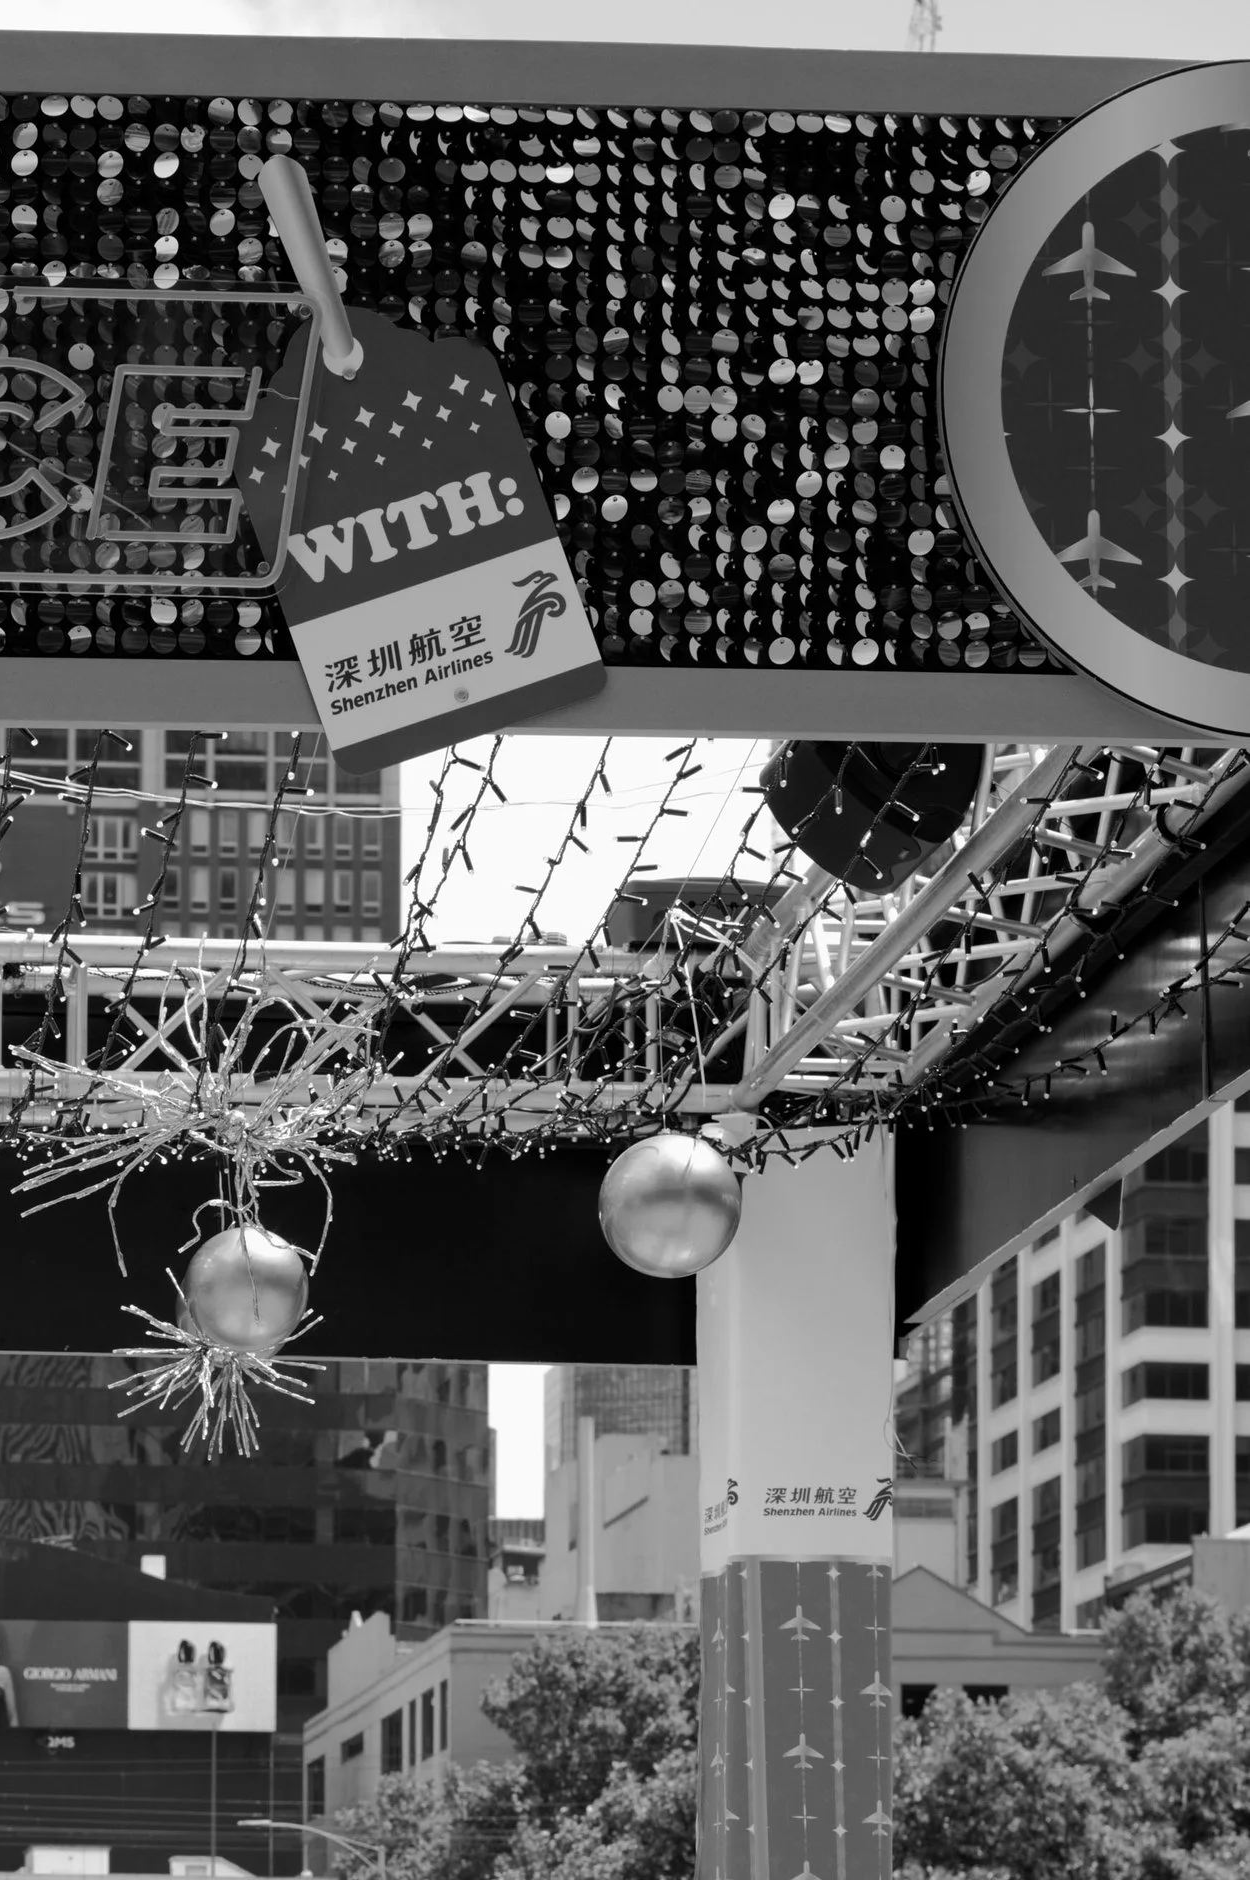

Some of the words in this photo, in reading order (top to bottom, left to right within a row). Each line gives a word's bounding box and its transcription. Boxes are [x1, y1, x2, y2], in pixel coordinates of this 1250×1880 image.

[287, 471, 524, 583] WITH:
[324, 614, 486, 693] 深圳航空
[330, 675, 418, 716] Shenzhen
[424, 650, 494, 684] Airlines
[762, 1507, 815, 1517] Shenzhen
[818, 1507, 858, 1517] Airlines
[764, 1486, 857, 1505] 深圳航空
[23, 1666, 72, 1681] GIORGIO
[73, 1667, 118, 1682] ARMANI
